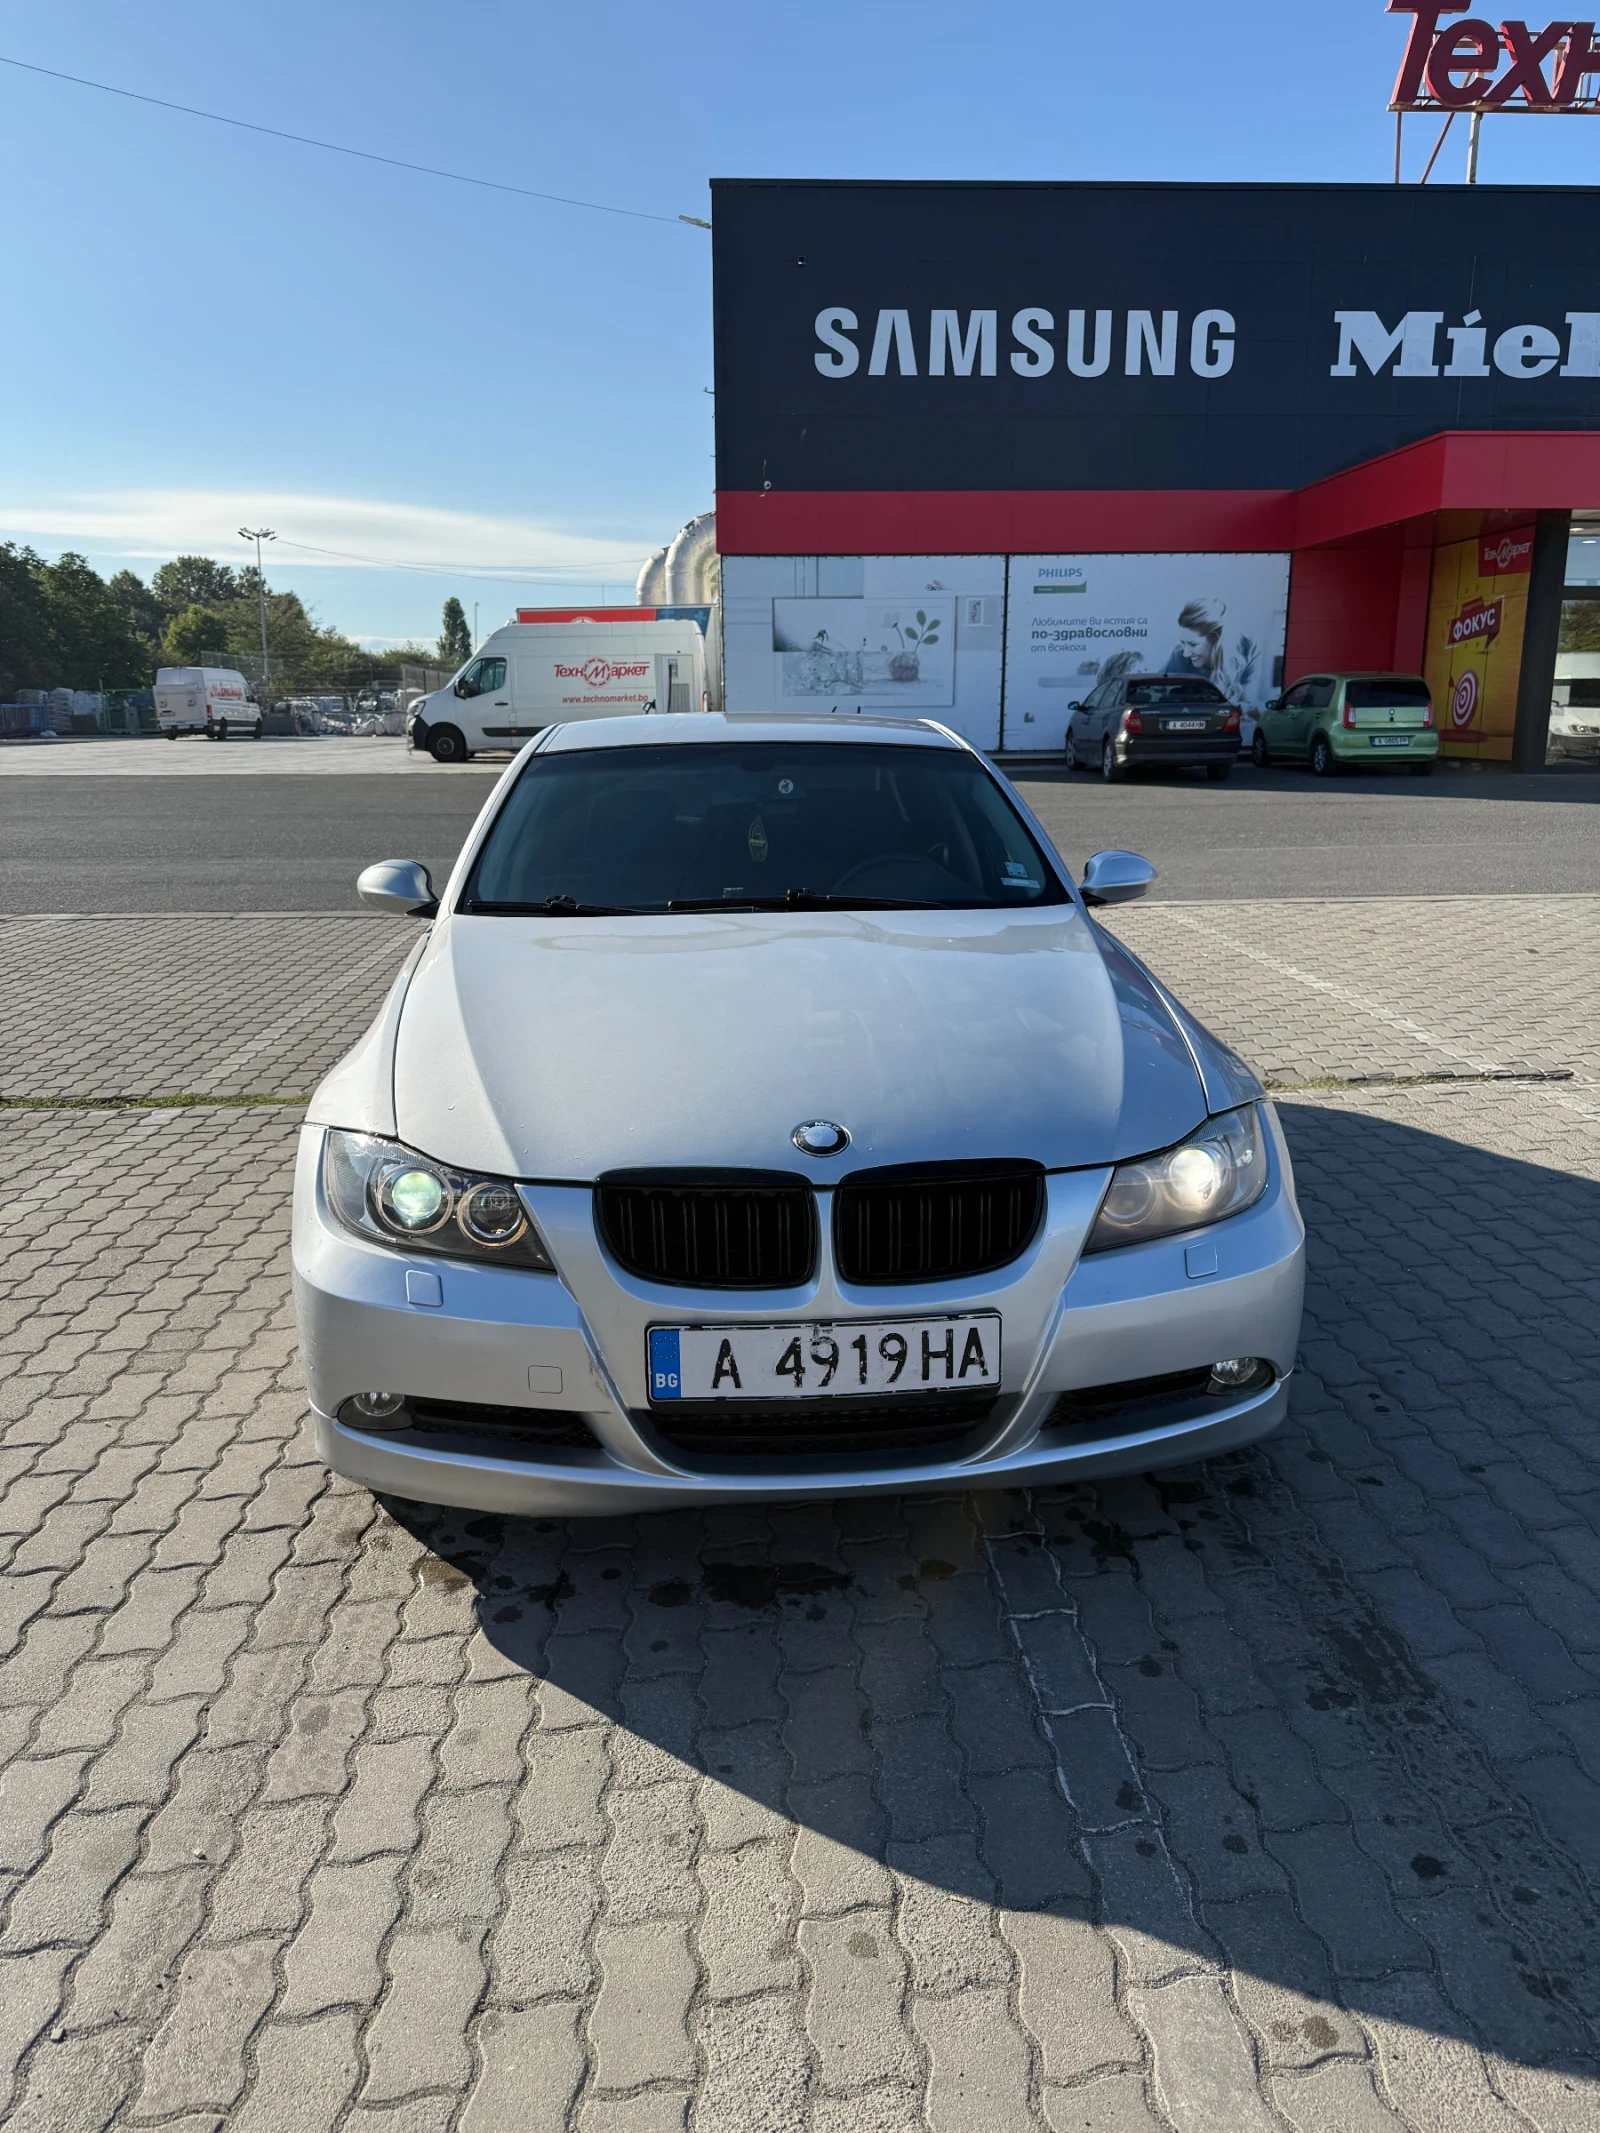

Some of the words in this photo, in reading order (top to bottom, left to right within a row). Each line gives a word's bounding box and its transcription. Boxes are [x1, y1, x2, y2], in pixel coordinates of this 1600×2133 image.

[814, 307, 1236, 378] SAMSUNG
[1038, 568, 1083, 578] PHILIPS
[1031, 617, 1087, 627] Любимите
[1089, 616, 1101, 626] ви
[1103, 617, 1135, 625] ястия
[1453, 608, 1496, 640] ФОКУС
[1031, 626, 1148, 641] по-здравословни
[1030, 644, 1046, 652] от
[1048, 642, 1087, 652] всякога
[562, 693, 648, 704] www.technomarket.bg
[711, 1339, 743, 1389] A
[775, 1327, 989, 1388] 4919HA
[655, 1373, 678, 1388] BG
